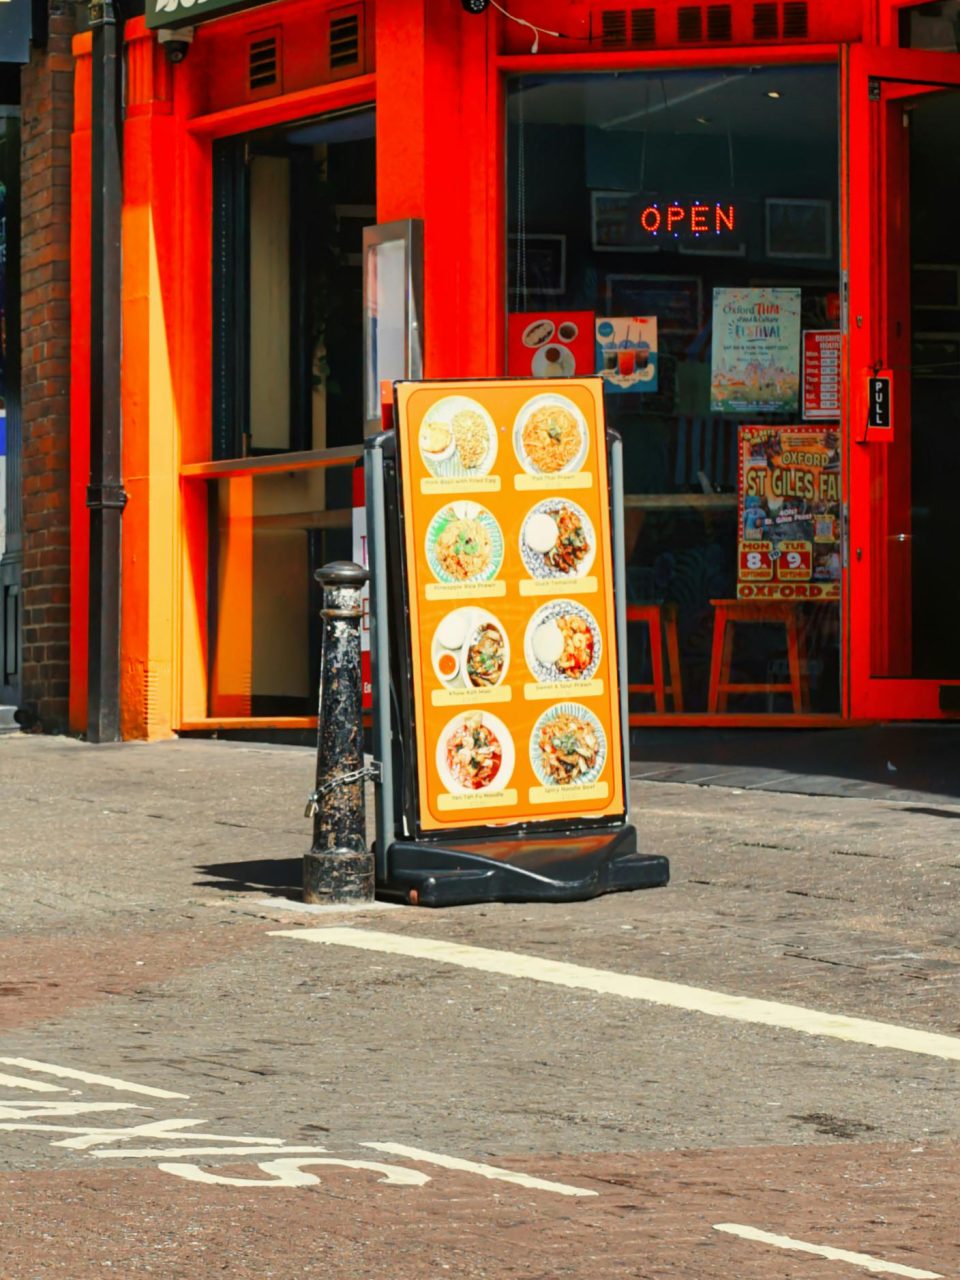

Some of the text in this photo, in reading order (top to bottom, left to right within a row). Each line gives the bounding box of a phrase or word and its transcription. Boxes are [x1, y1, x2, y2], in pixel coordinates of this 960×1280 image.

[641, 205, 735, 232] OPEN
[875, 381, 883, 424] PULL
[782, 451, 829, 466] OXFORD
[747, 469, 767, 496] ST
[772, 468, 814, 499] GILES
[739, 585, 823, 597] OXFORD
